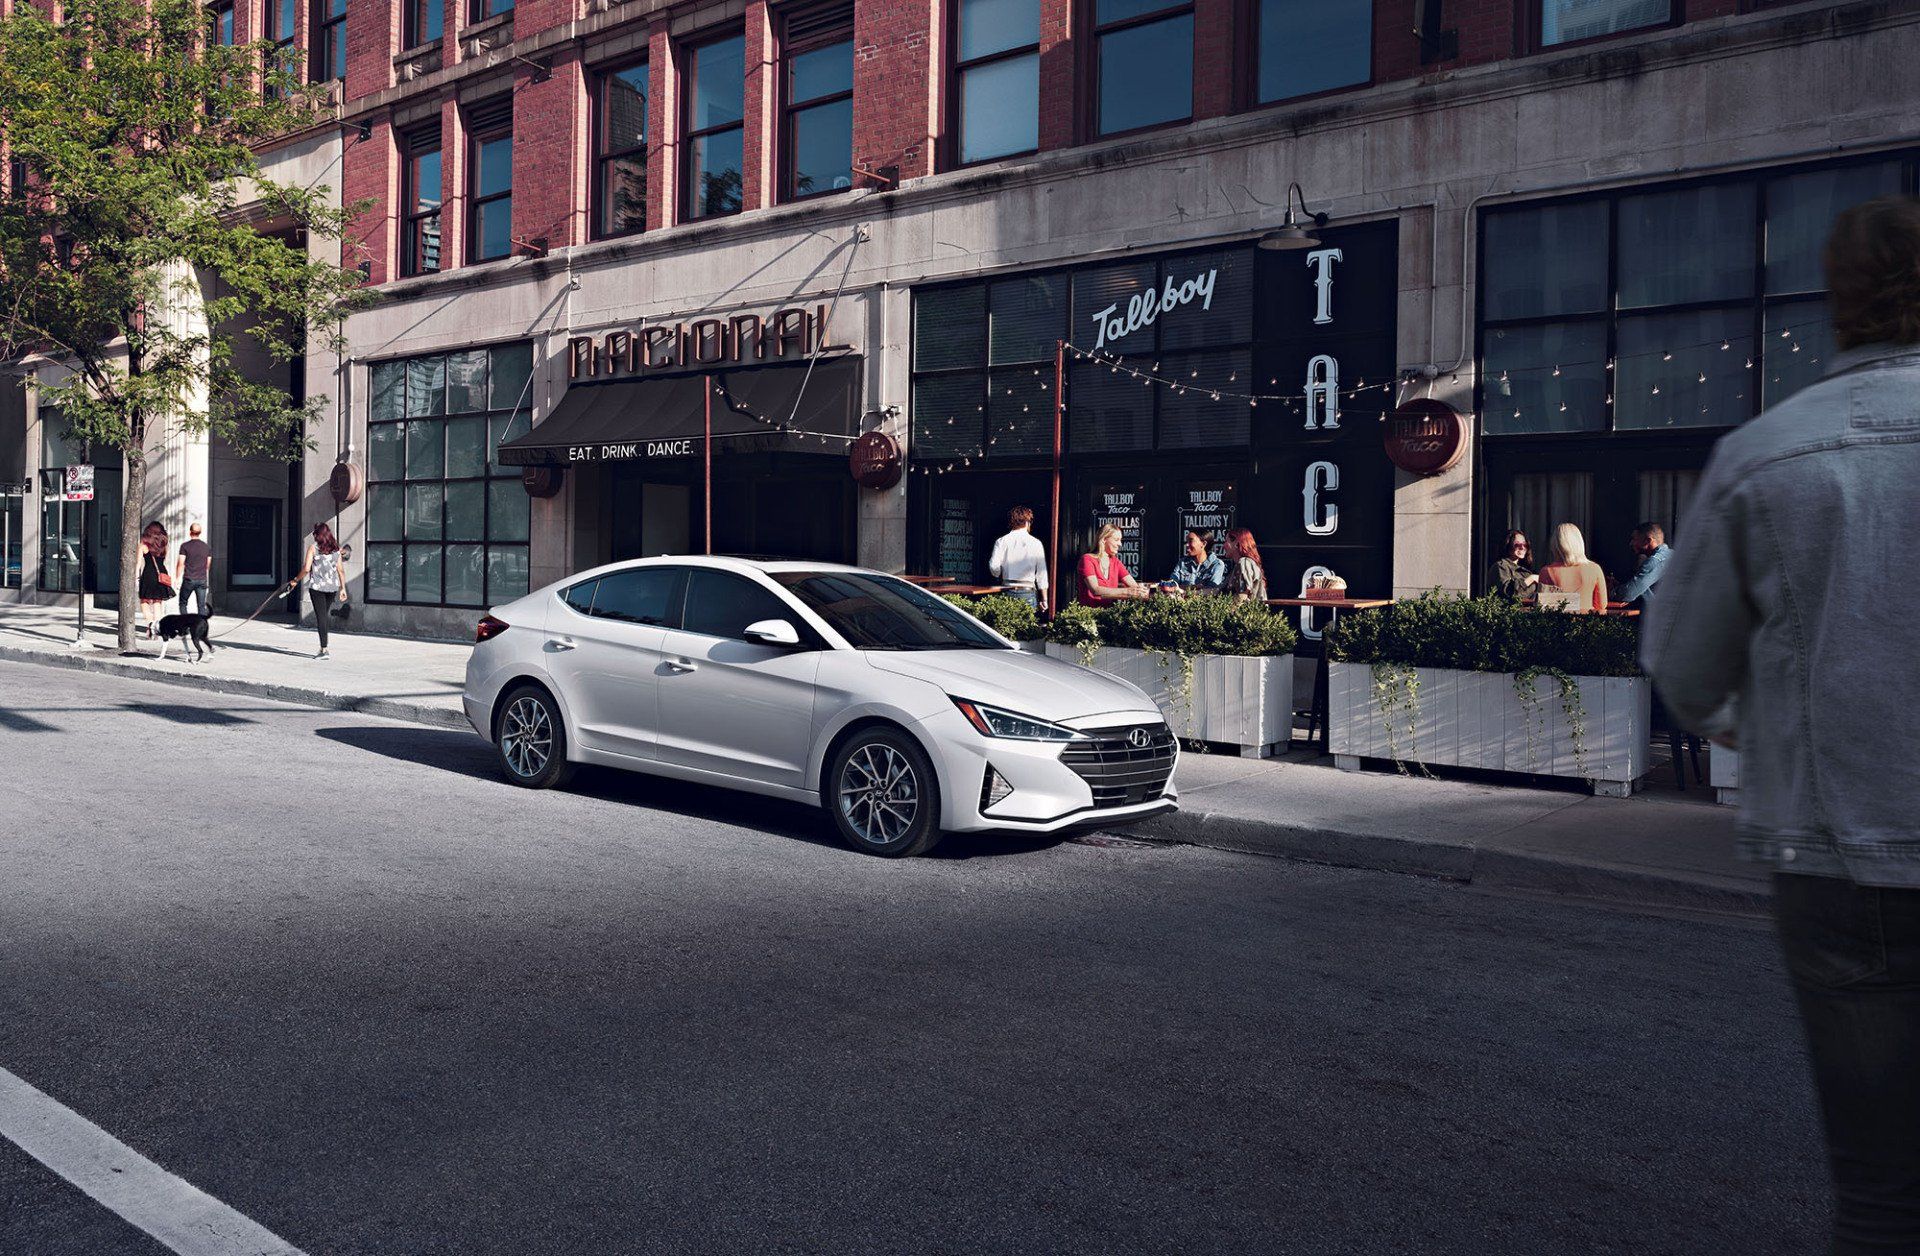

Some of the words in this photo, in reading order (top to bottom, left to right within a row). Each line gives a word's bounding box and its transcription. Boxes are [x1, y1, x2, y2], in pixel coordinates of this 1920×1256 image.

[1092, 269, 1217, 349] Tallboy
[567, 304, 857, 379] NACIONAL
[569, 447, 596, 460] EAT.
[602, 444, 642, 459] DRINK.
[648, 441, 694, 456] DANCE.
[1104, 494, 1134, 505] TALLBOY
[1189, 491, 1223, 502] TALLBOY
[1108, 505, 1130, 514] Taco
[1194, 502, 1218, 512] Taco
[1184, 515, 1221, 528] TALLBOYS
[1223, 515, 1229, 527] Y
